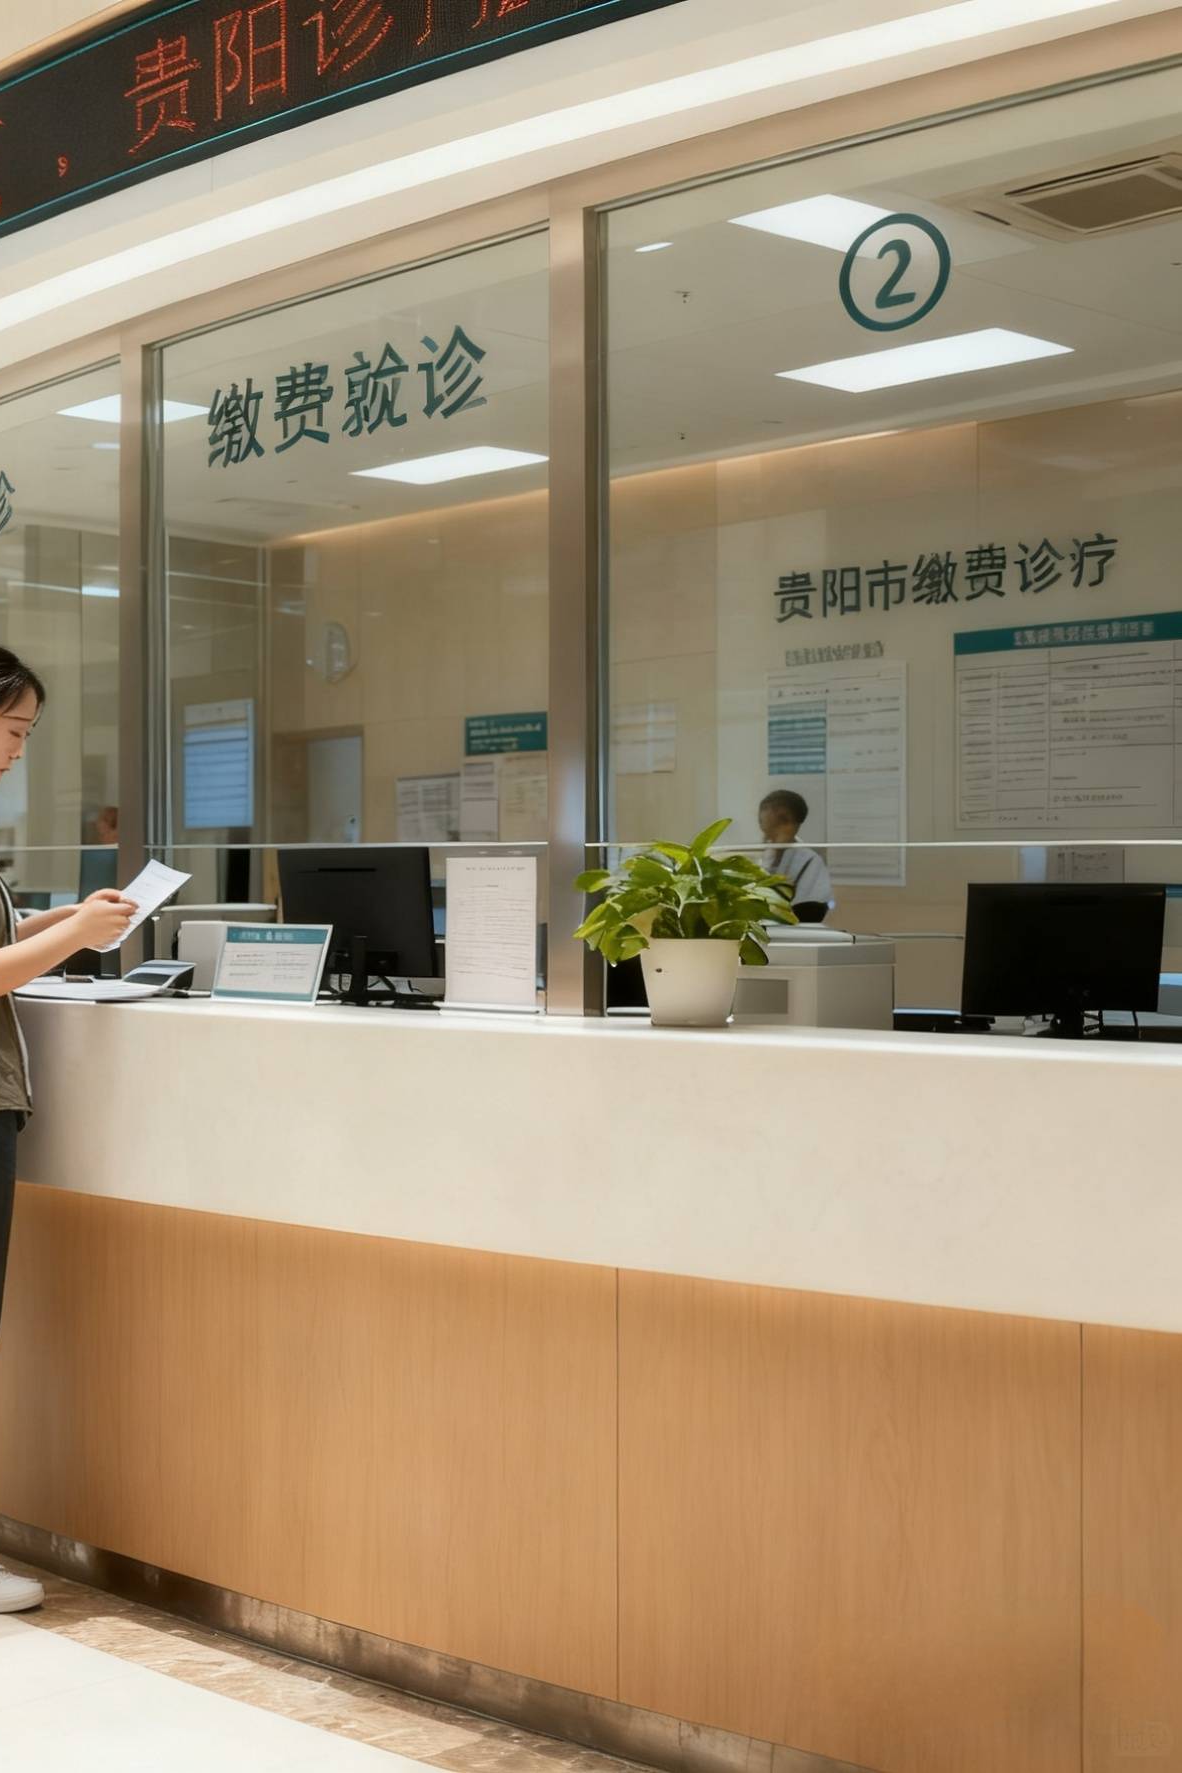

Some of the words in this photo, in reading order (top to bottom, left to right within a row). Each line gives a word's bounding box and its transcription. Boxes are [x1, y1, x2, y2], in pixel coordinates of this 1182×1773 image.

[124, 0, 528, 153] 贵阳诊
[208, 325, 486, 468] 缴费就诊
[774, 533, 1118, 623] 贵阳市缴费诊疗
